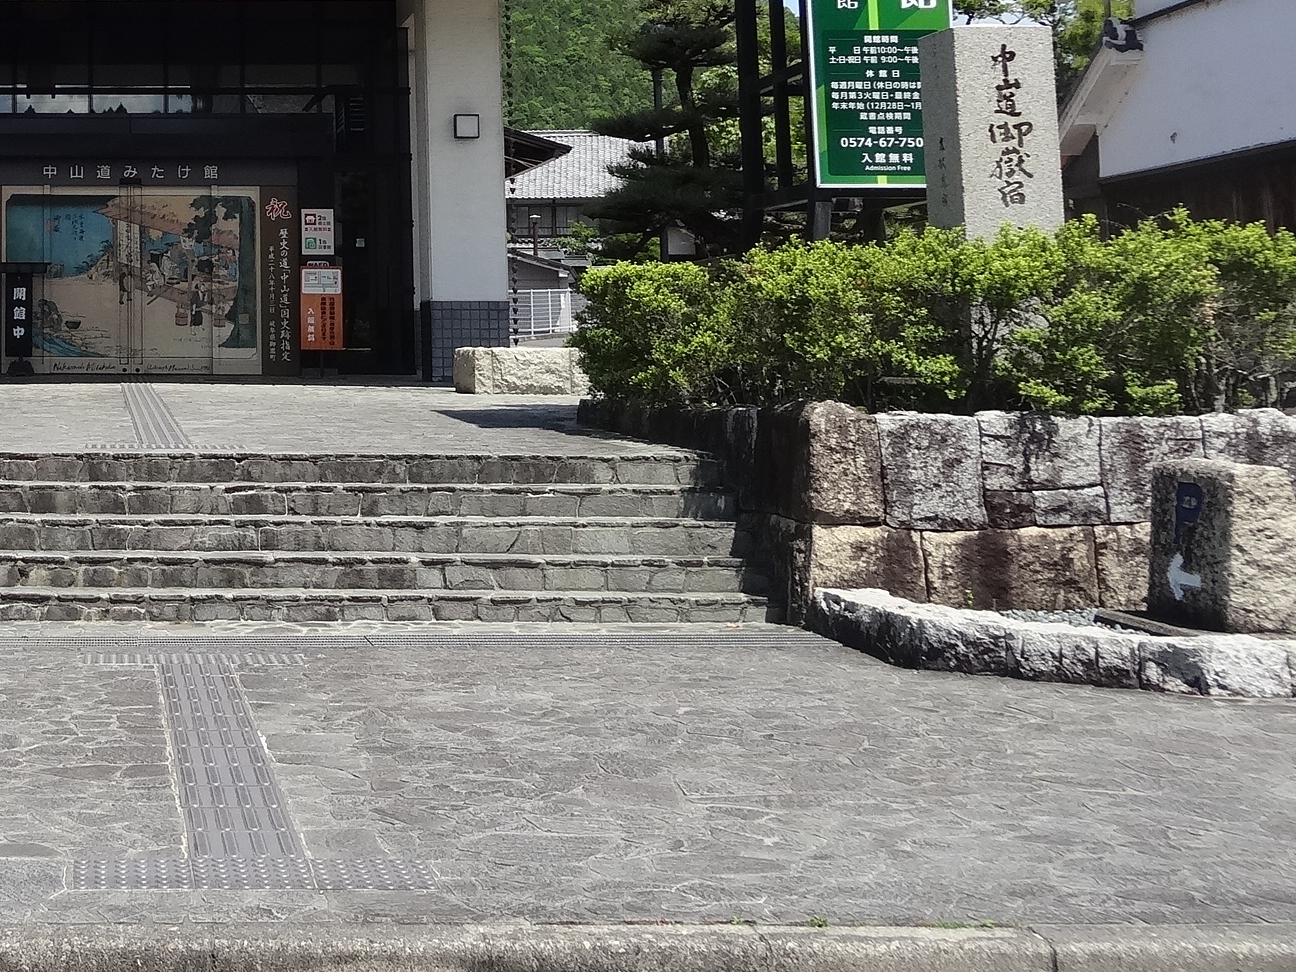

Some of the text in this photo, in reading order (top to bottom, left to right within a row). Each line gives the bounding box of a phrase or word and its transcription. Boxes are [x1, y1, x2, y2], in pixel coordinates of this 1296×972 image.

[863, 35, 899, 43] 開館時間
[865, 70, 900, 78] 休館日
[868, 126, 903, 135] 電話番号
[840, 137, 924, 147] 0574-67-750
[861, 153, 914, 163] 入館無料
[43, 164, 218, 179] 中山道みたけ館
[265, 197, 292, 221] 祝
[12, 287, 27, 339] 開館中
